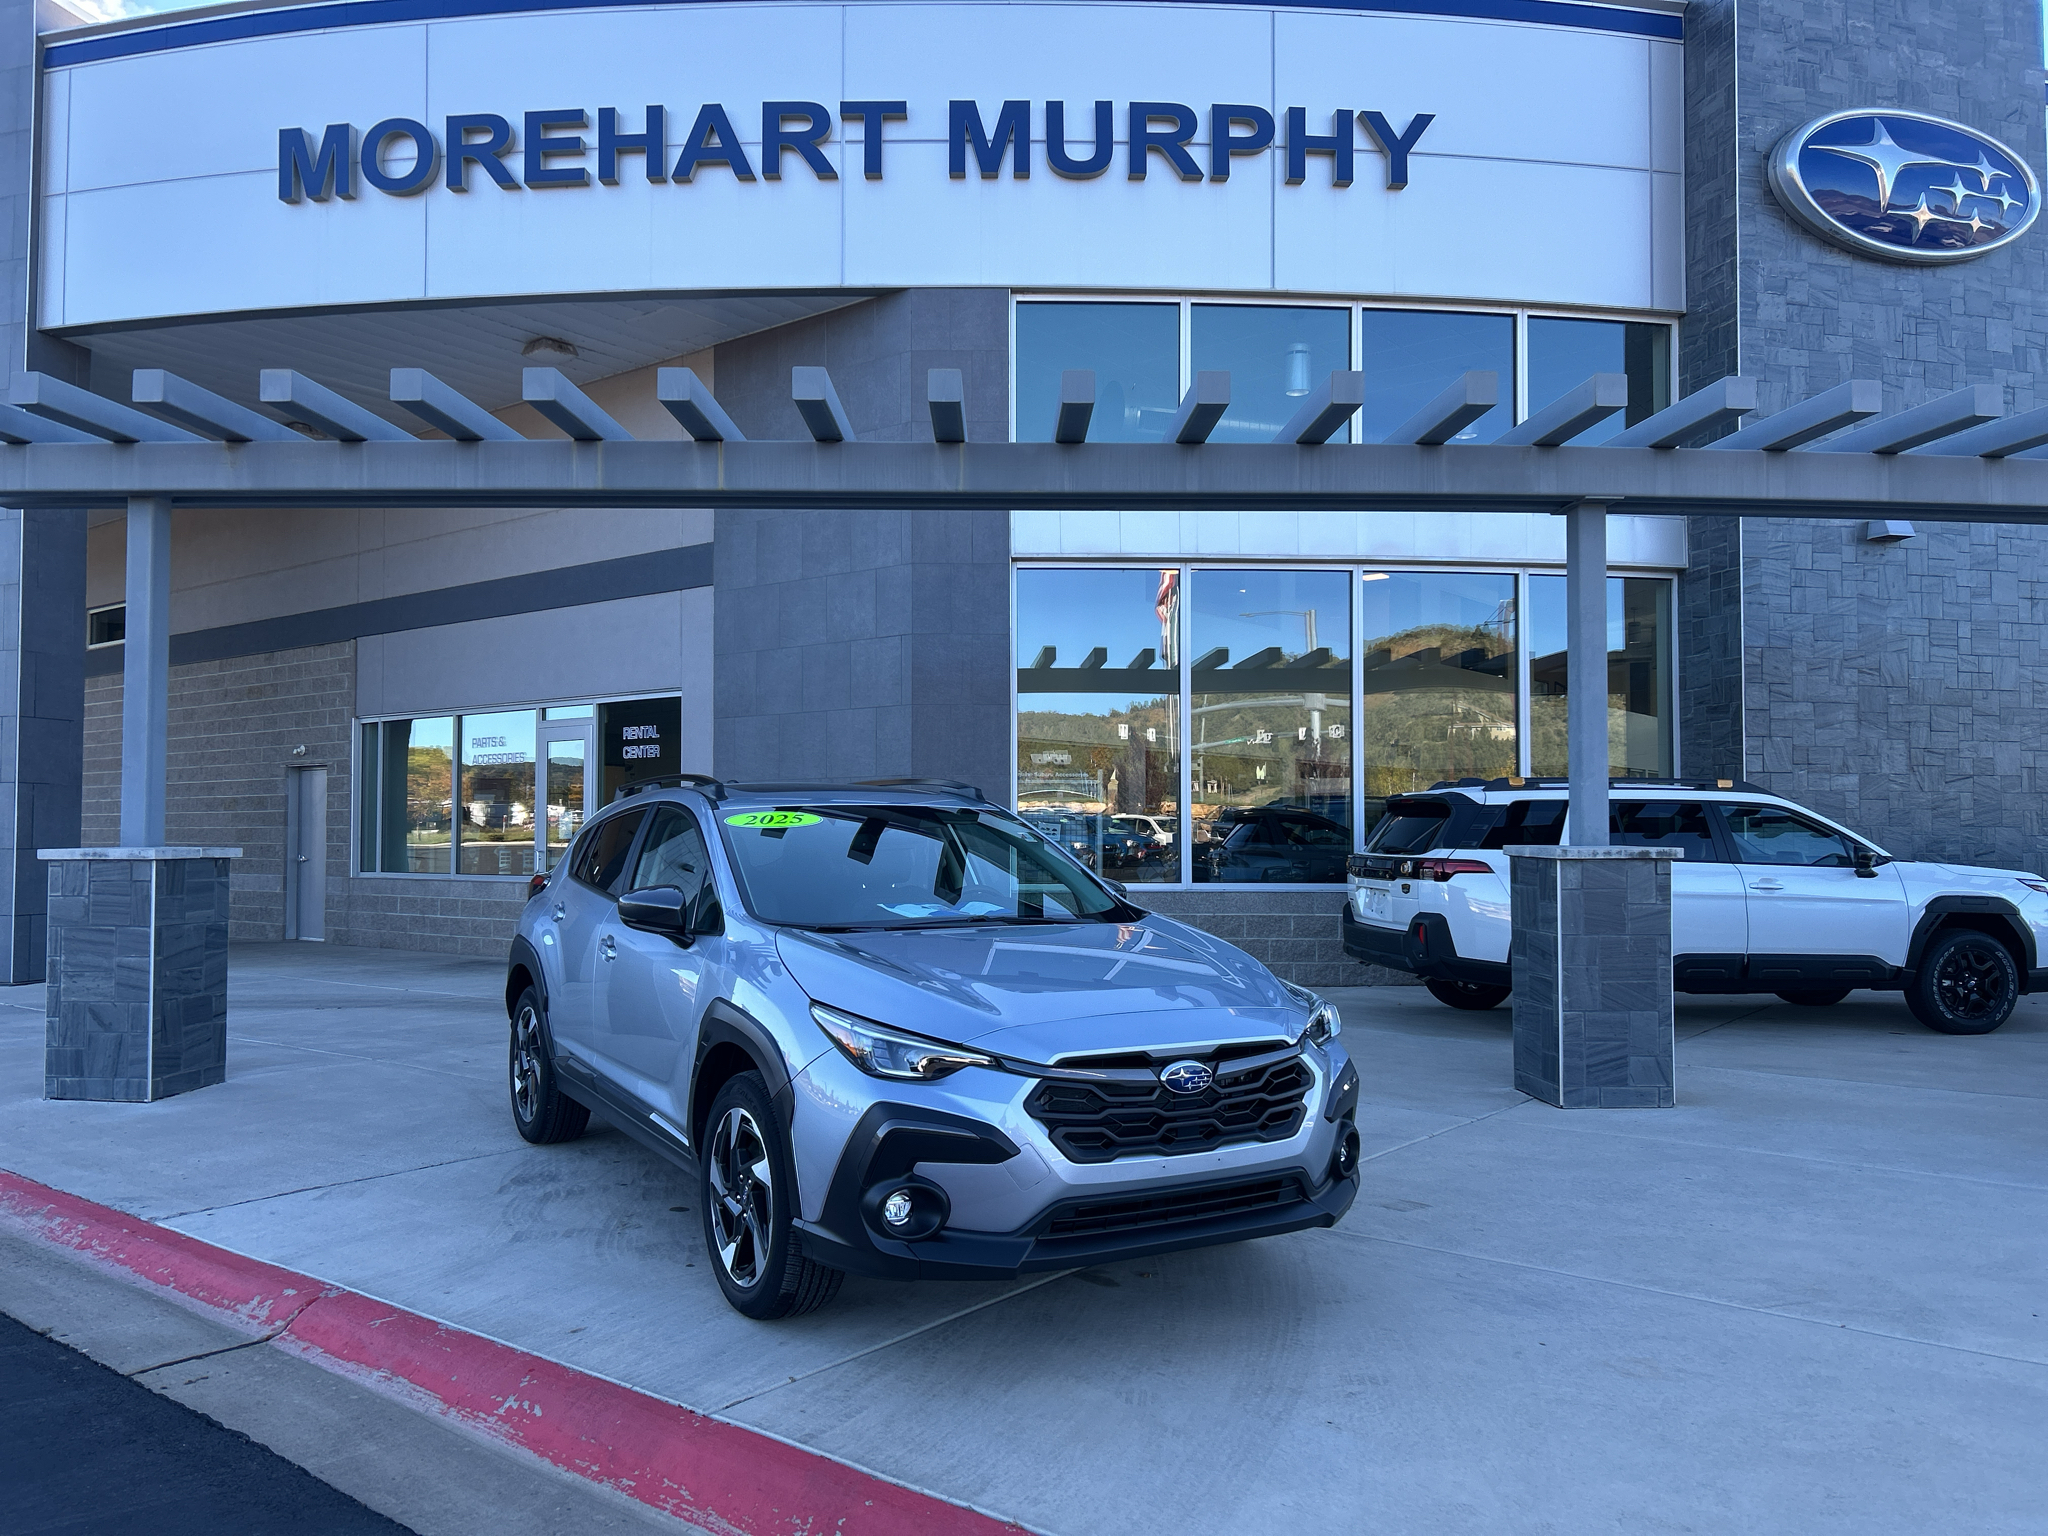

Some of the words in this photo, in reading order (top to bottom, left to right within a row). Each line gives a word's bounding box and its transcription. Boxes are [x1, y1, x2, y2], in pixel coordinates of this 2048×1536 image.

[279, 100, 907, 204] MOREHART
[949, 99, 1436, 191] MURPHY
[623, 725, 660, 740] RENTAL
[472, 737, 498, 748] PARTS
[498, 736, 507, 747] &
[472, 752, 525, 765] ACCESSORIES
[623, 745, 660, 759] CENTER
[743, 814, 804, 826] 2025
